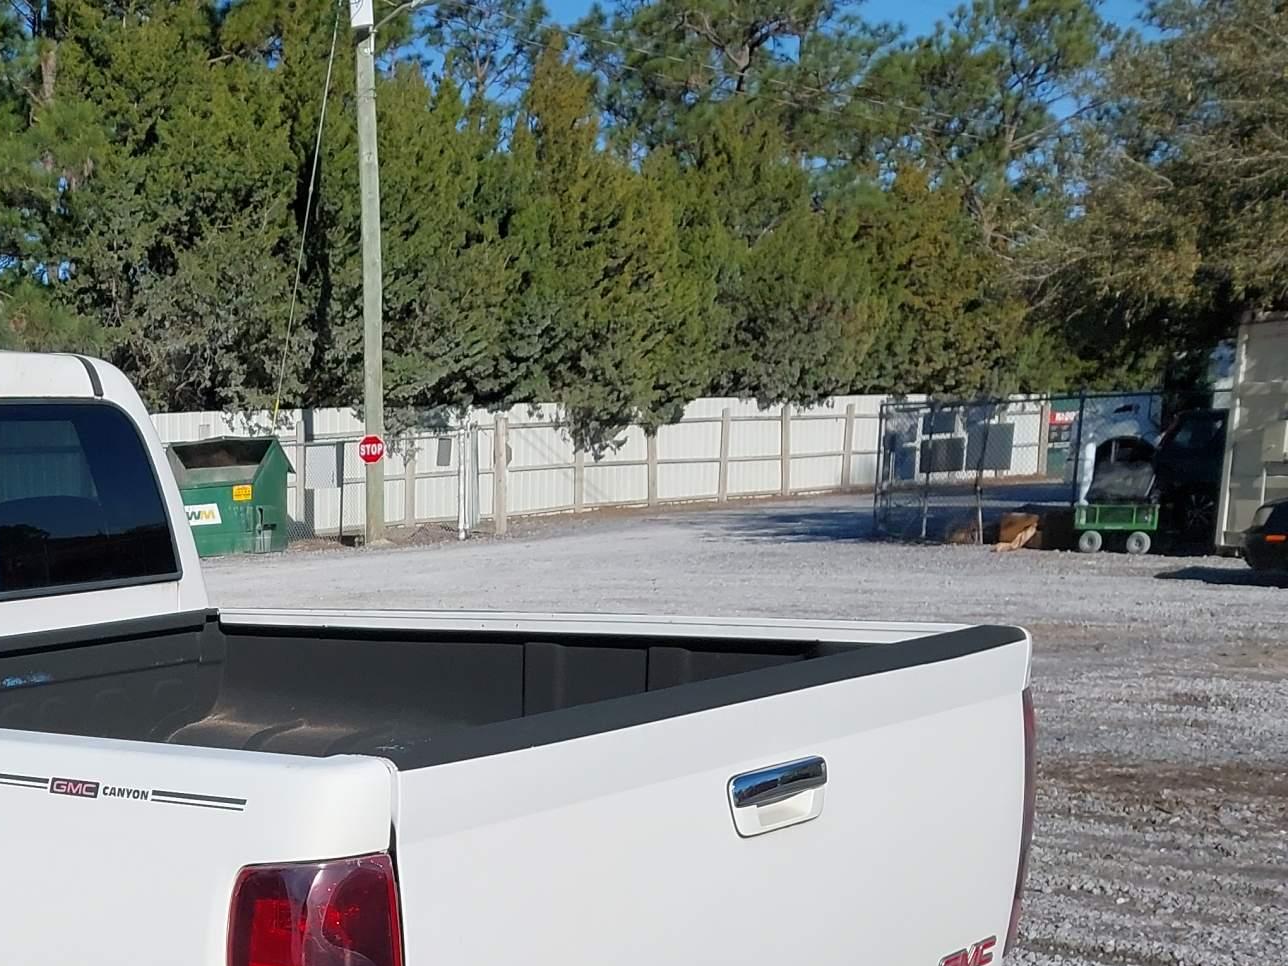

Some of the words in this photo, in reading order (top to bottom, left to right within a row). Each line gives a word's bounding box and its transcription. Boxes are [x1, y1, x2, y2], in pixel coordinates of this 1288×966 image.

[360, 443, 383, 456] STOP
[186, 511, 215, 521] WM
[52, 780, 97, 797] GMC
[102, 786, 150, 801] CANYON
